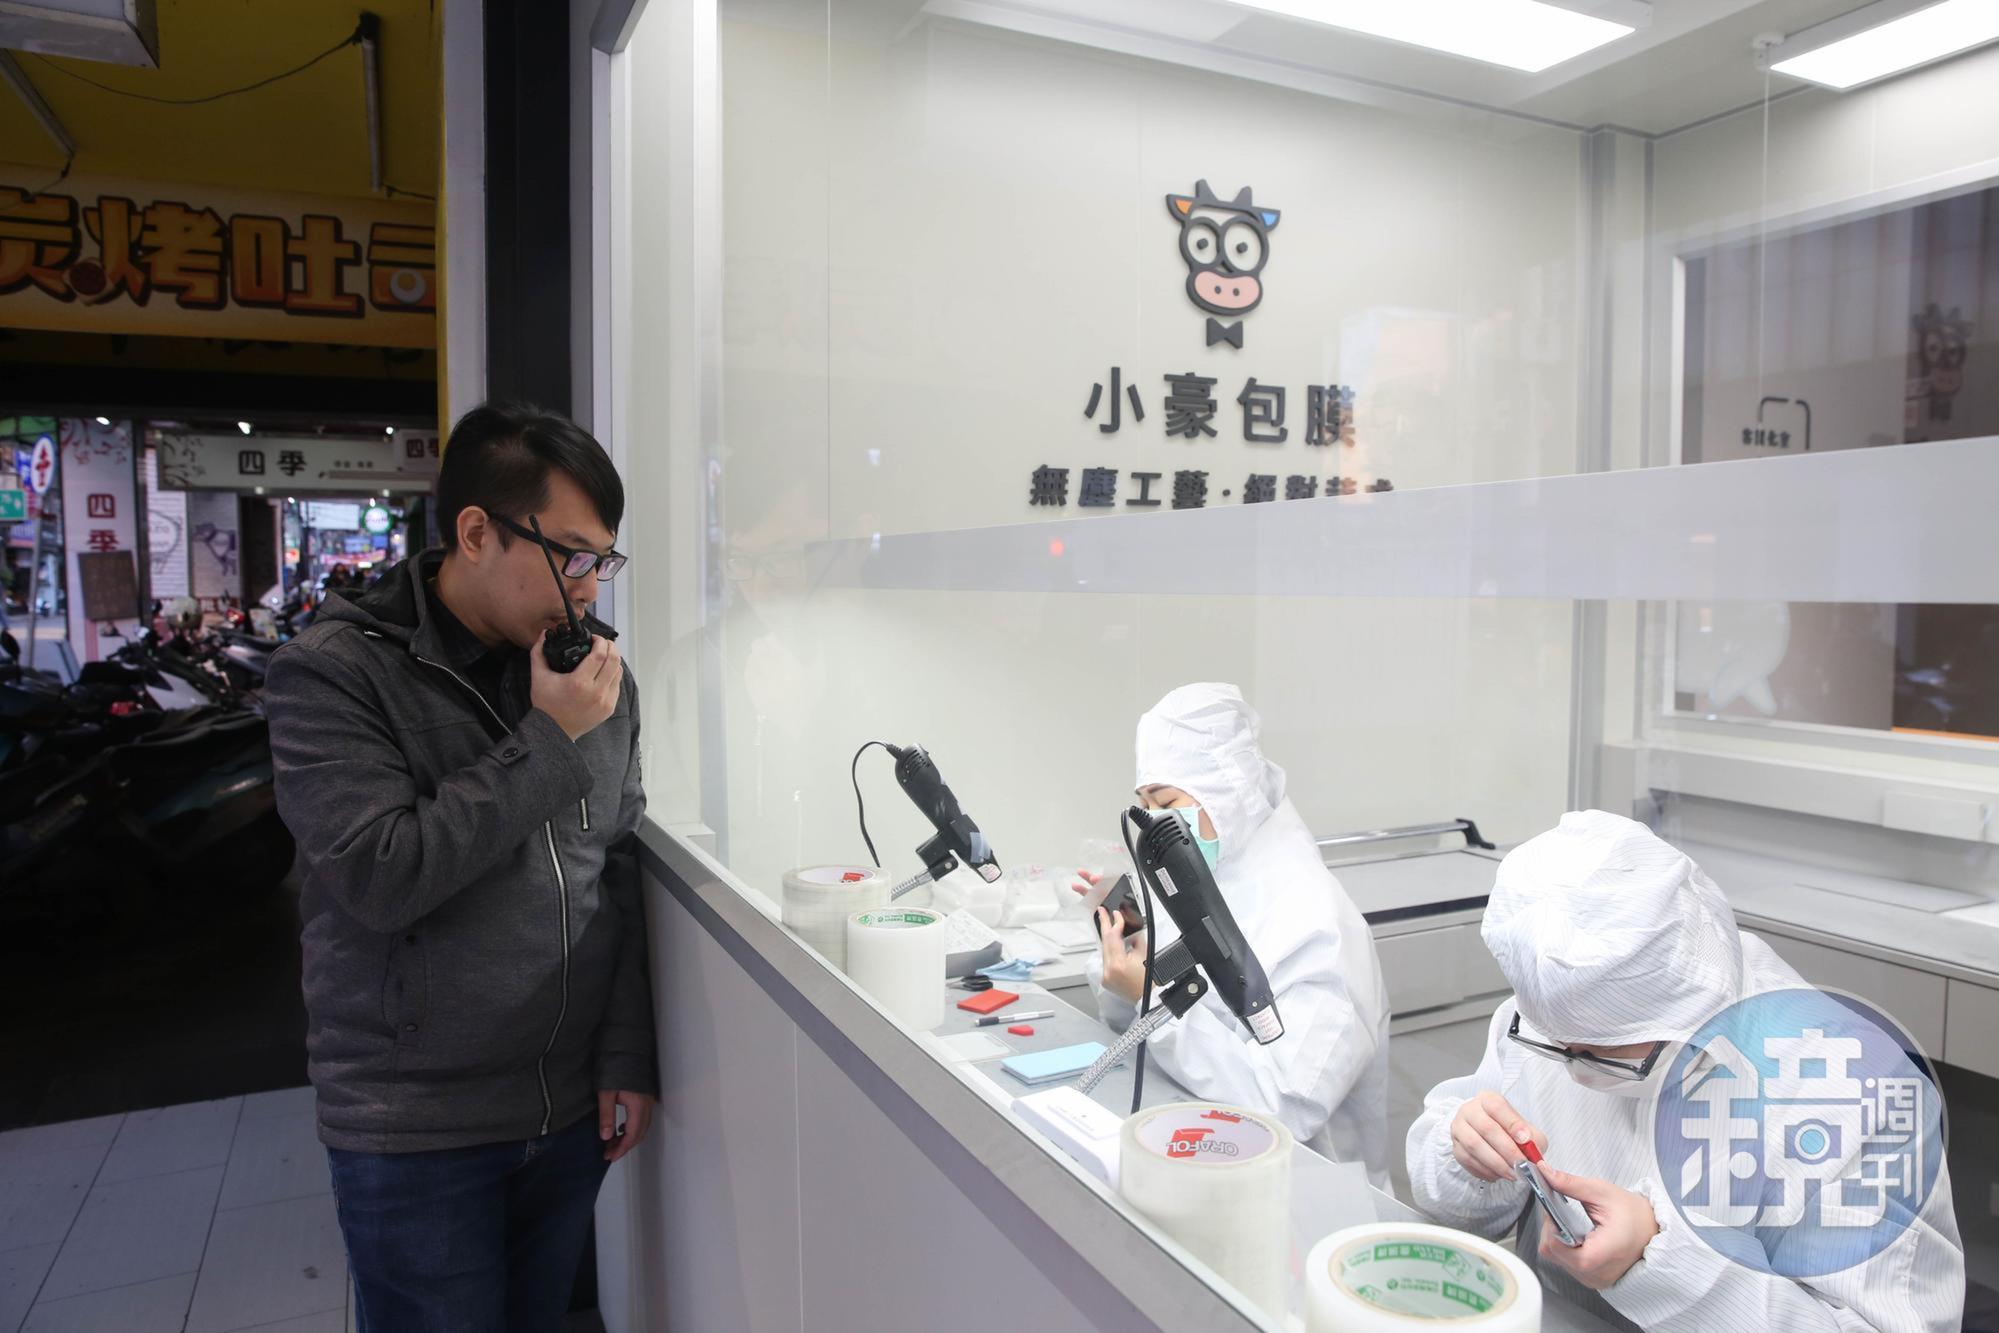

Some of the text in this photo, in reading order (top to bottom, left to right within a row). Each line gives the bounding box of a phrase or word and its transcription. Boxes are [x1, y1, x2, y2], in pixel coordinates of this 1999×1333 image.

[1084, 366, 1356, 448] 小豪包膜
[238, 450, 307, 477] 四季
[87, 493, 119, 552] 四季
[1166, 1139, 1239, 1157] ORAFOL
